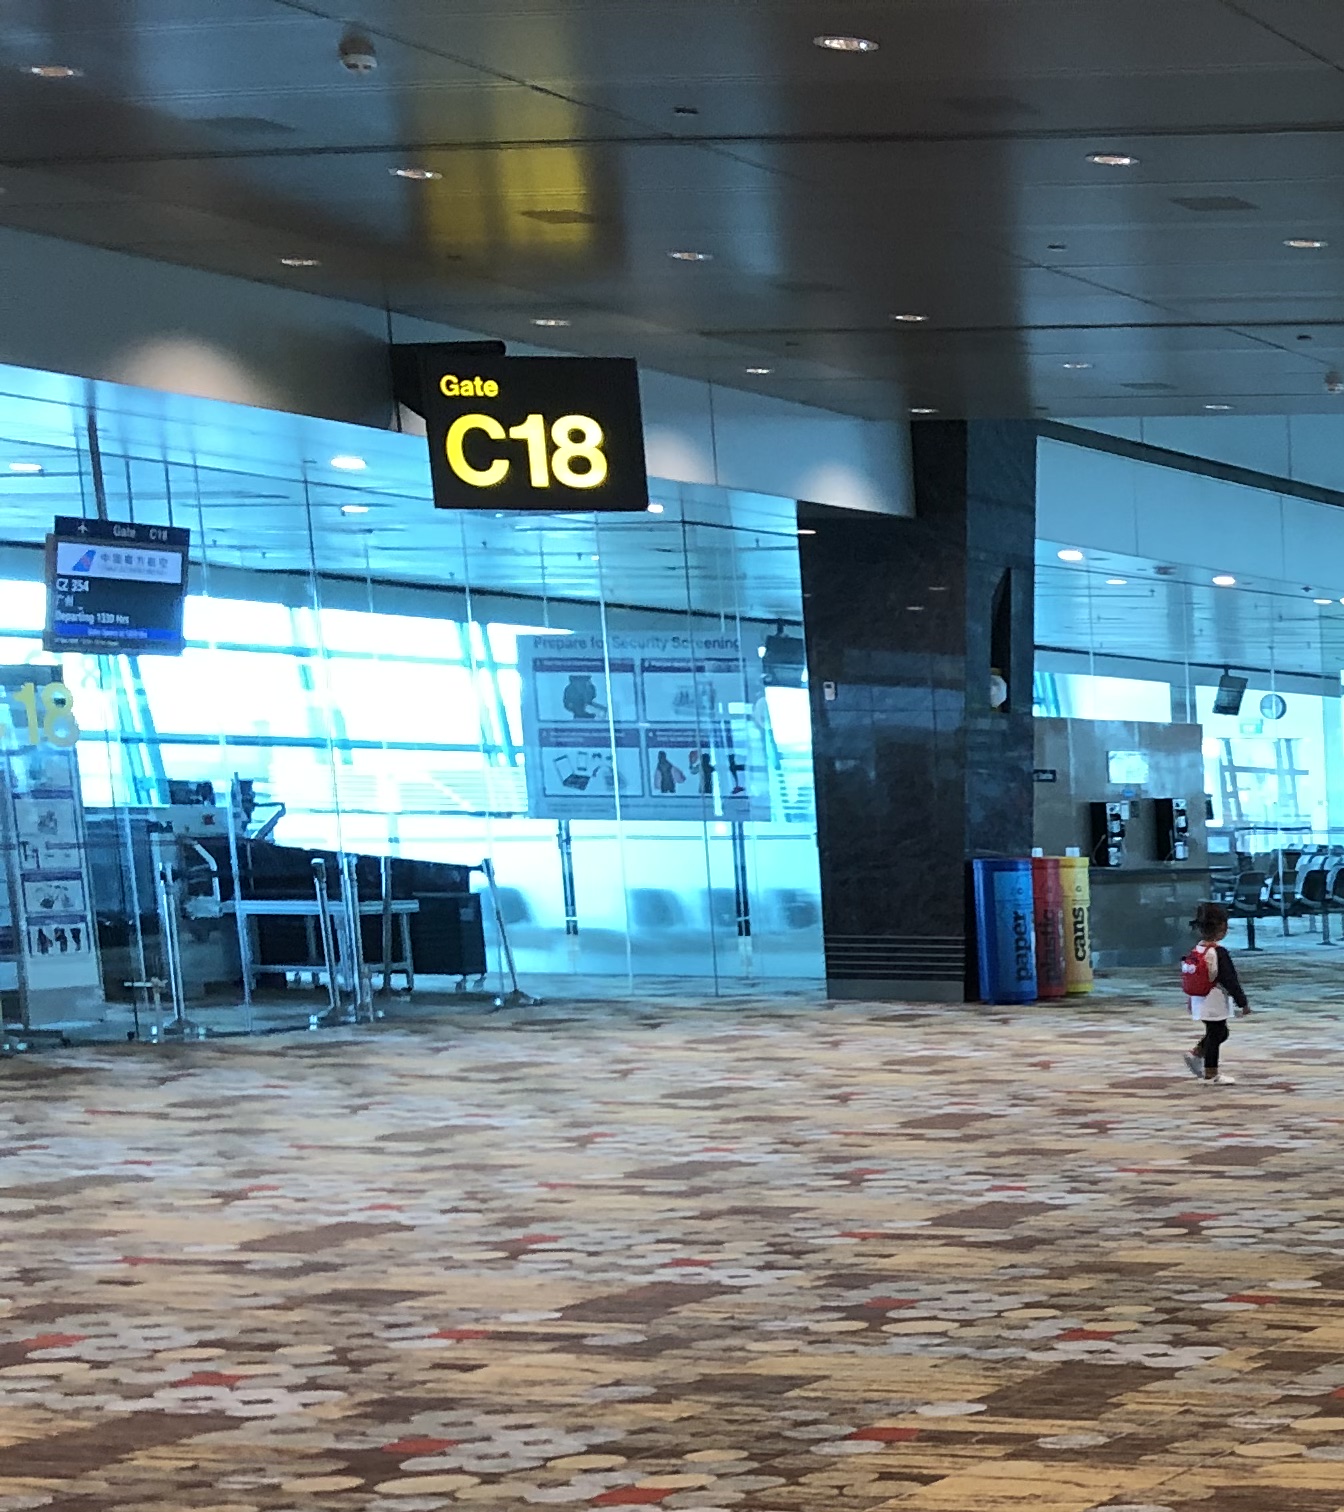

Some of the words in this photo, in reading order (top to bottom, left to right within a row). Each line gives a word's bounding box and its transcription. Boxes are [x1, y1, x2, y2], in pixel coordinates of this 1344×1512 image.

[440, 375, 499, 397] Gate
[446, 413, 608, 489] C18
[533, 636, 587, 651] Prepare
[590, 637, 607, 650] fo
[613, 636, 667, 652] Security
[0, 682, 80, 747] 18
[1012, 911, 1032, 981] paper
[1072, 906, 1086, 962] cans
